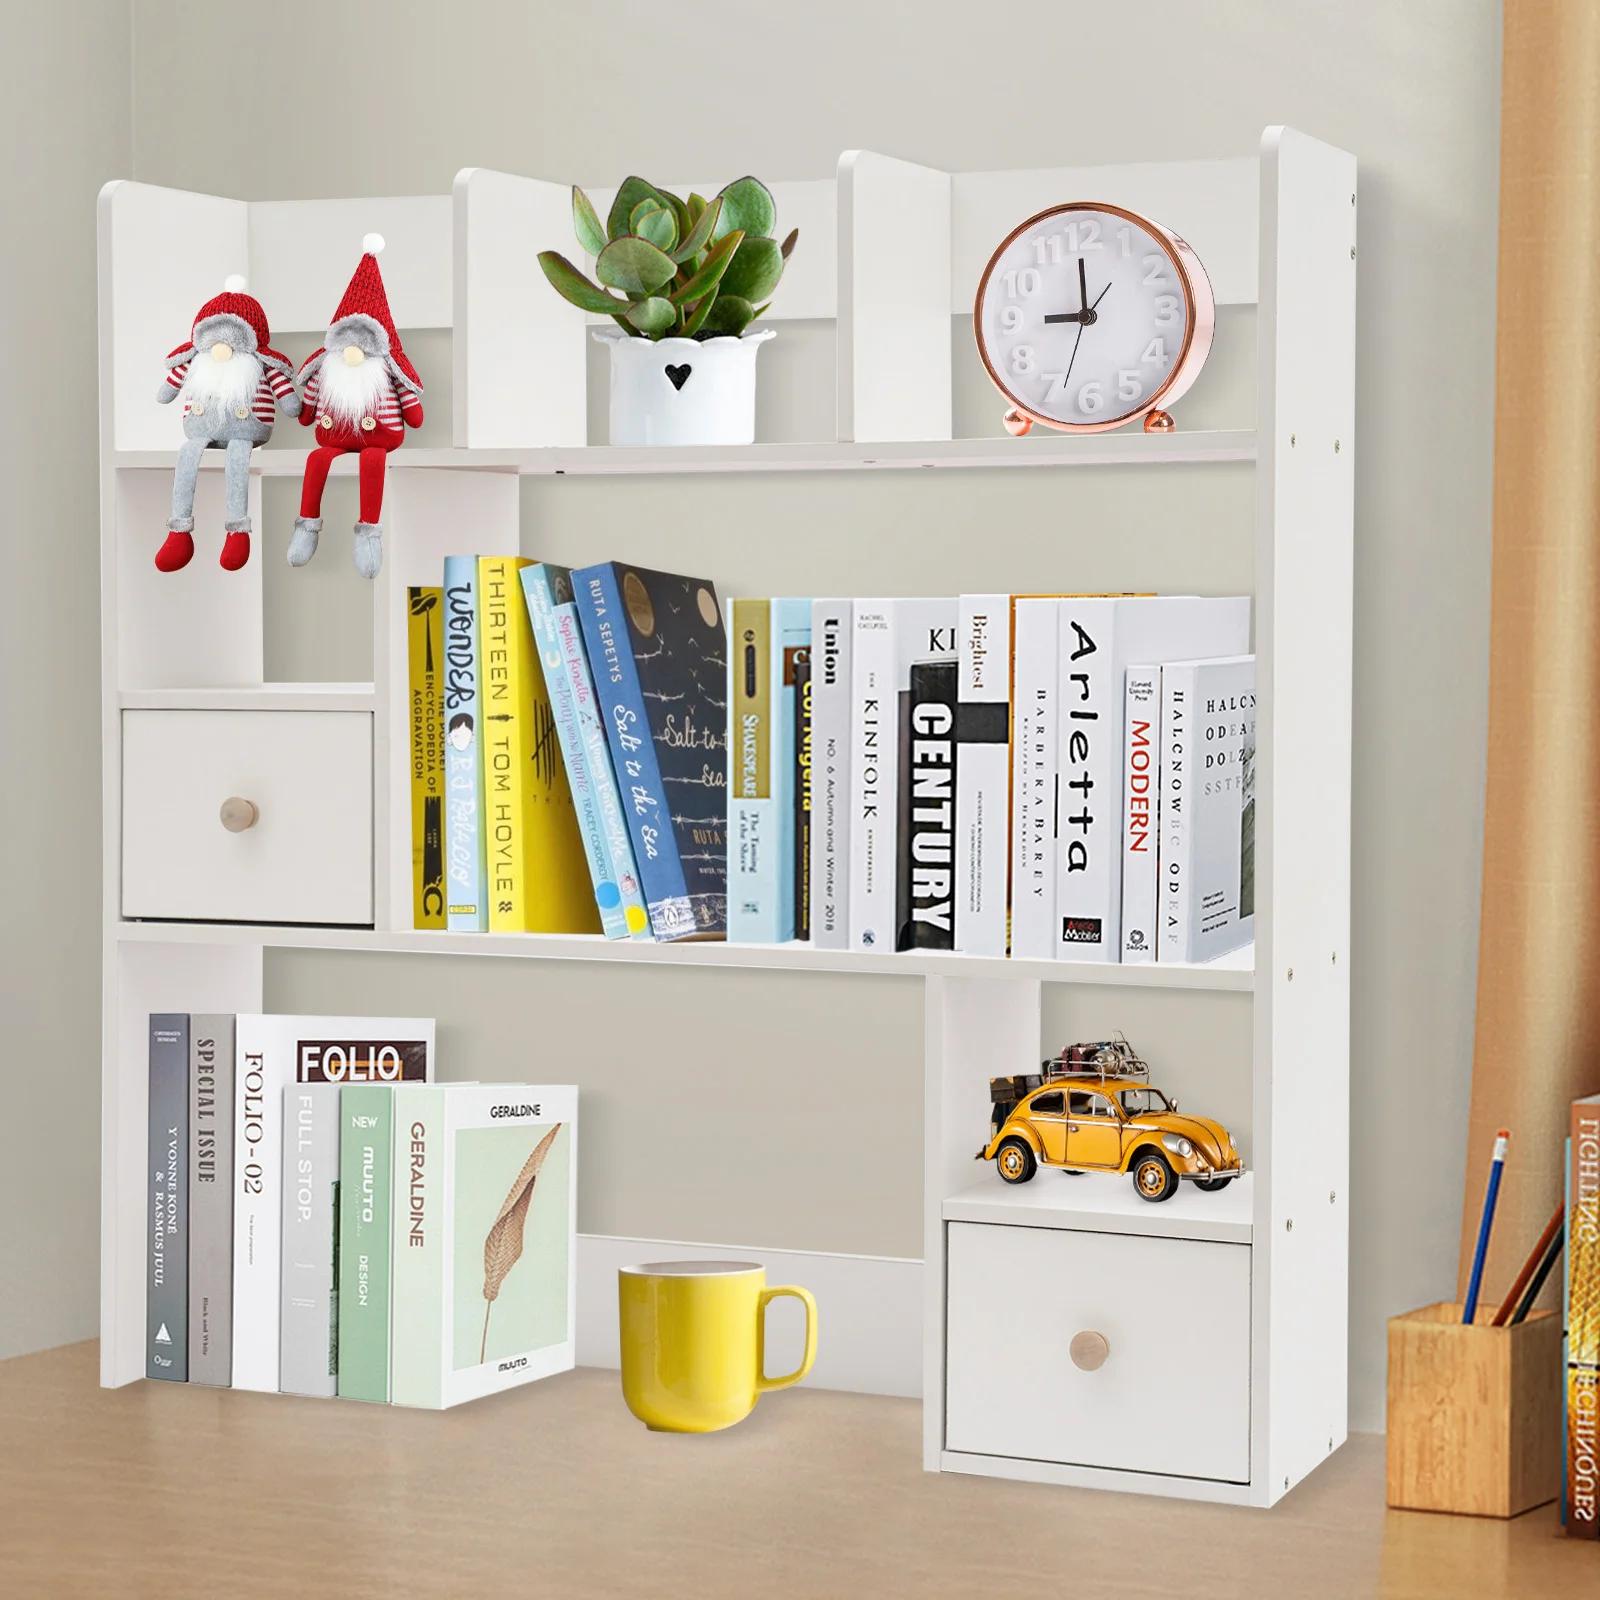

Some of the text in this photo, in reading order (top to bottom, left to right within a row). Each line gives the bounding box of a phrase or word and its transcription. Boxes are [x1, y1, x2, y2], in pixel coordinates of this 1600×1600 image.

[1032, 234, 1061, 264] 11
[1064, 219, 1102, 251] 12
[1116, 227, 1131, 257] 1
[1002, 267, 1040, 298] 10
[1143, 254, 1167, 285] 2
[1001, 304, 1023, 335] 9
[1154, 294, 1179, 328] 3
[1011, 345, 1034, 375] 8
[1141, 338, 1168, 369] 4
[1040, 373, 1060, 402] 7
[1078, 382, 1104, 414] 6
[1118, 370, 1142, 401] 5
[589, 579, 622, 683] RUTA SEPETYS
[824, 619, 839, 685] Union
[968, 615, 988, 689] Brightest
[413, 689, 424, 779] AGGRAVATION
[425, 674, 436, 792] ENCYCLOPEDIA OF
[488, 562, 513, 891] THIRTEEN TOM HOYLE
[613, 704, 642, 752] Salt
[664, 713, 699, 749] Salt
[702, 726, 717, 750] to
[743, 714, 759, 797] SHAKESPEARE
[863, 699, 879, 819] KINFOLK
[1068, 620, 1098, 873] Arletta
[626, 759, 643, 777] to
[701, 763, 727, 788] Sea
[1129, 719, 1151, 852] MODERN
[631, 786, 658, 816] the
[826, 779, 836, 826] Autumn
[911, 702, 953, 932] CENTURY
[692, 829, 721, 846] RUTA
[826, 828, 835, 853] and
[825, 857, 835, 897] Winter
[825, 904, 835, 931] 2018
[301, 1044, 400, 1082] FOLIO
[197, 1039, 216, 1183] SPECIAL ISSUE
[352, 1116, 378, 1128] NEW
[490, 1104, 541, 1119] GERALDINE
[297, 1095, 313, 1222] FULL STOP.
[409, 1121, 426, 1247] GERALDINE
[154, 1171, 165, 1287] & RASMUS JUUL
[358, 1255, 368, 1306] DESIGN
